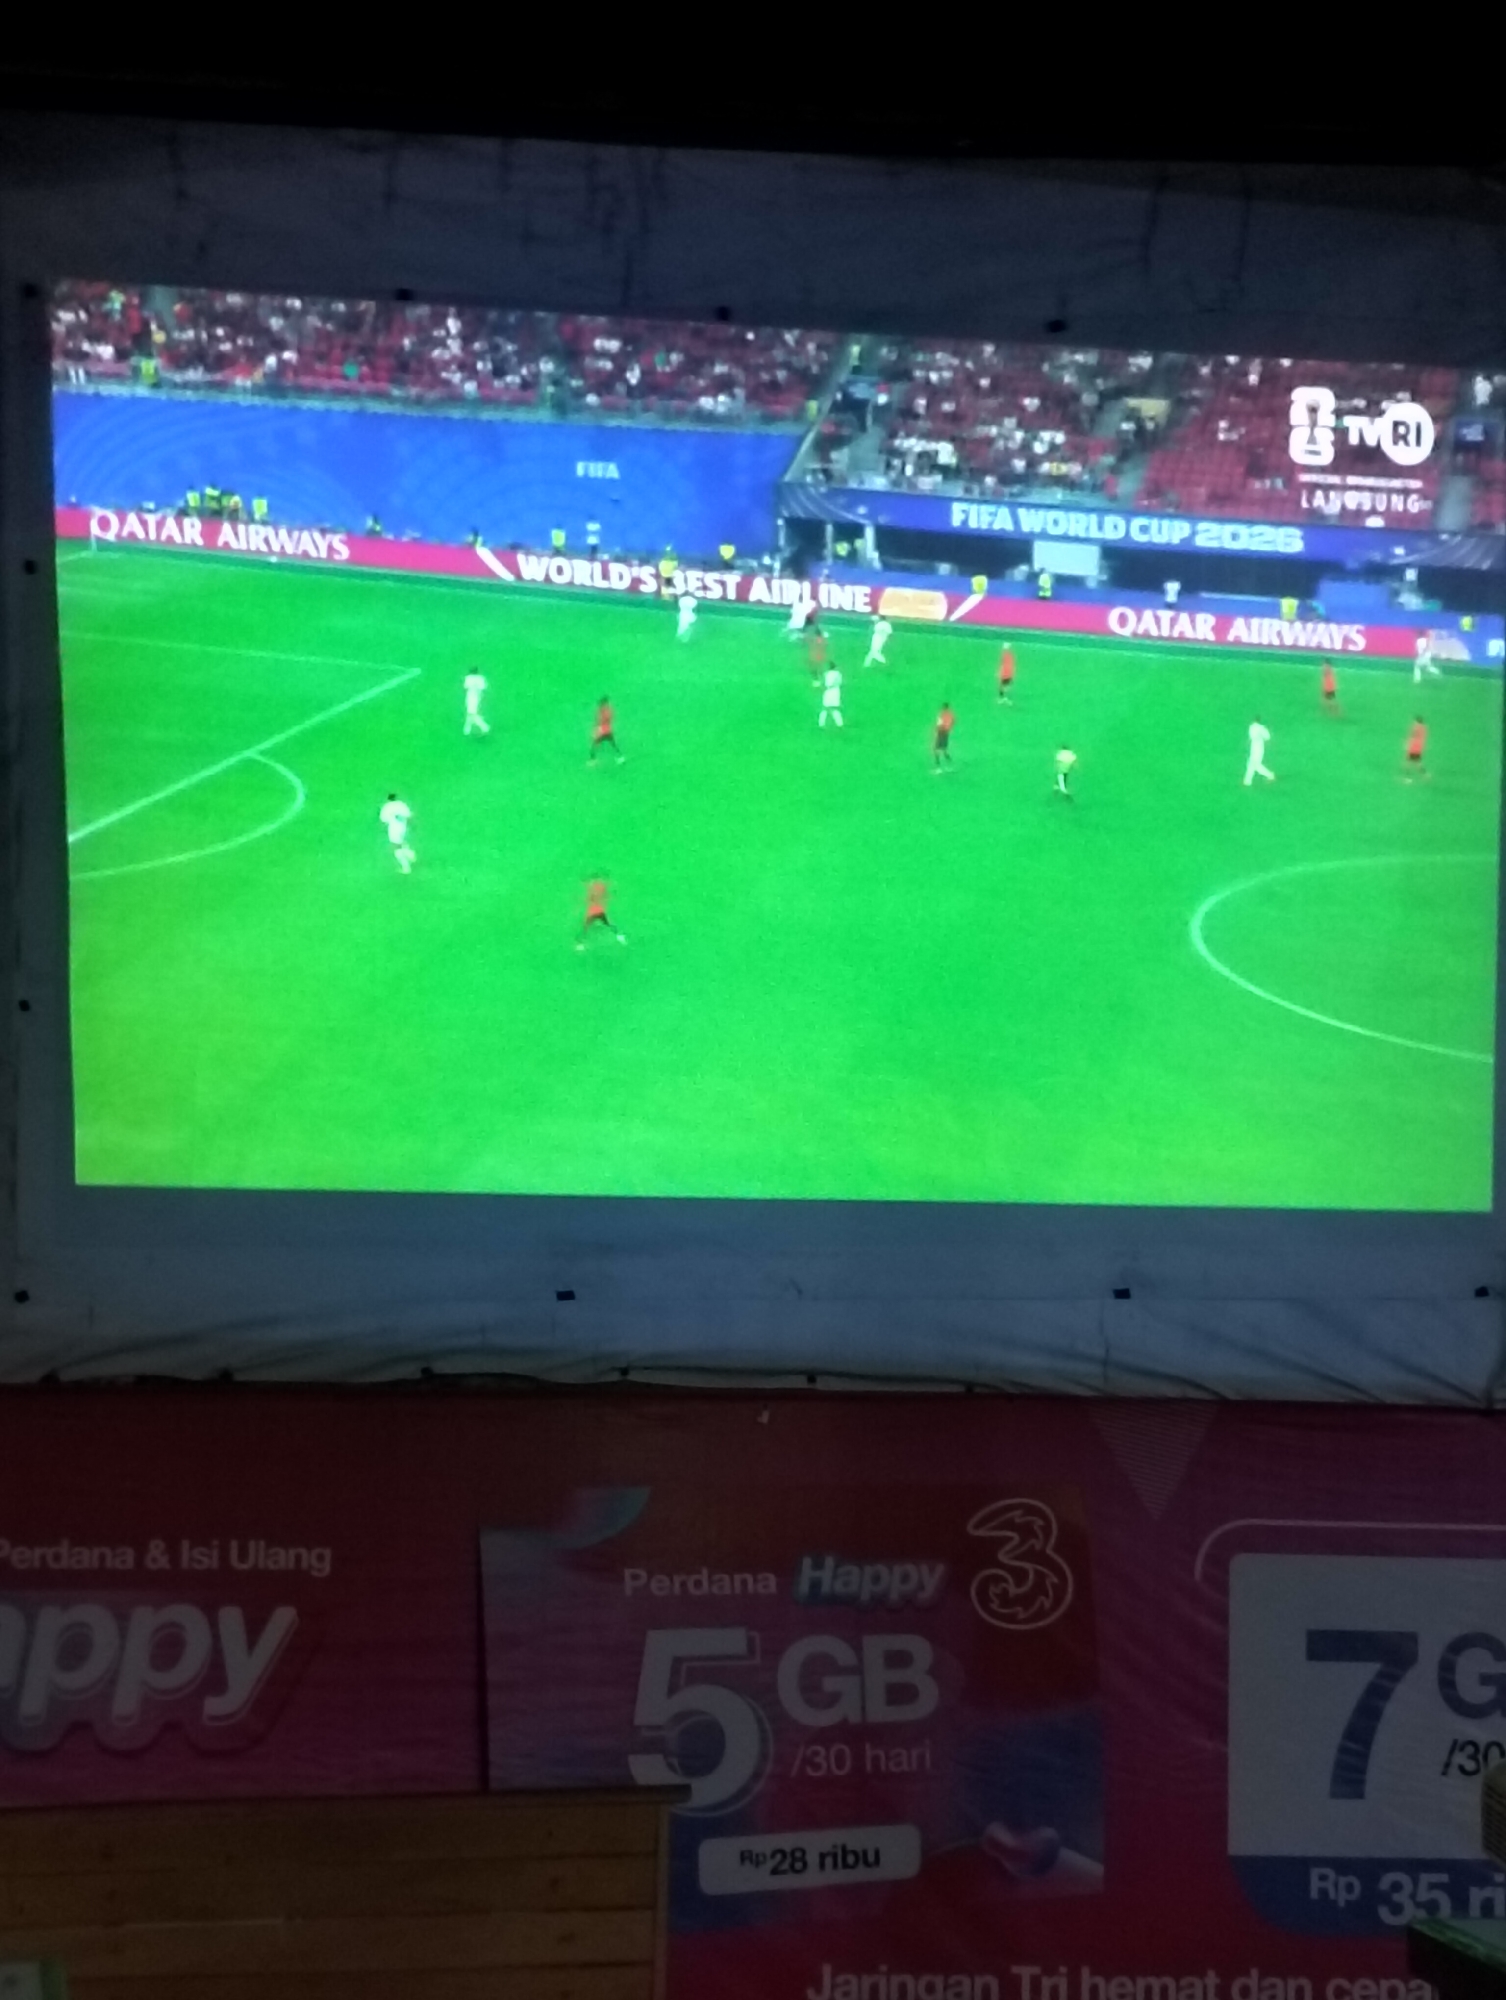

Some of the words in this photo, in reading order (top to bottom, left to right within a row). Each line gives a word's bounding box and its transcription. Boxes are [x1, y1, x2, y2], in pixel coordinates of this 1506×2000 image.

[90, 506, 204, 546] QATAR
[217, 522, 351, 560] AIRWAYS
[951, 502, 1015, 531] FIFA
[1017, 507, 1126, 540] WORLD
[1129, 519, 1191, 544] CUP
[1194, 522, 1304, 552] 2026
[517, 554, 658, 593] WORLD'S
[1108, 606, 1216, 641] QATAR
[1226, 617, 1367, 651] AIRWAYS
[144, 1539, 172, 1570] &
[181, 1539, 220, 1570] Isi
[230, 1539, 332, 1577] Ulang
[624, 1567, 777, 1596] Perdana
[801, 1555, 945, 1602] Happy
[627, 1626, 765, 1808] 5
[777, 1633, 939, 1727] GB
[1305, 1628, 1419, 1800] 7
[790, 1743, 851, 1778] /30
[864, 1739, 932, 1774] hari
[818, 1844, 881, 1871] ribu
[1309, 1867, 1361, 1908] Rp
[1377, 1872, 1451, 1926] 35
[1010, 1965, 1068, 2000] Tri
